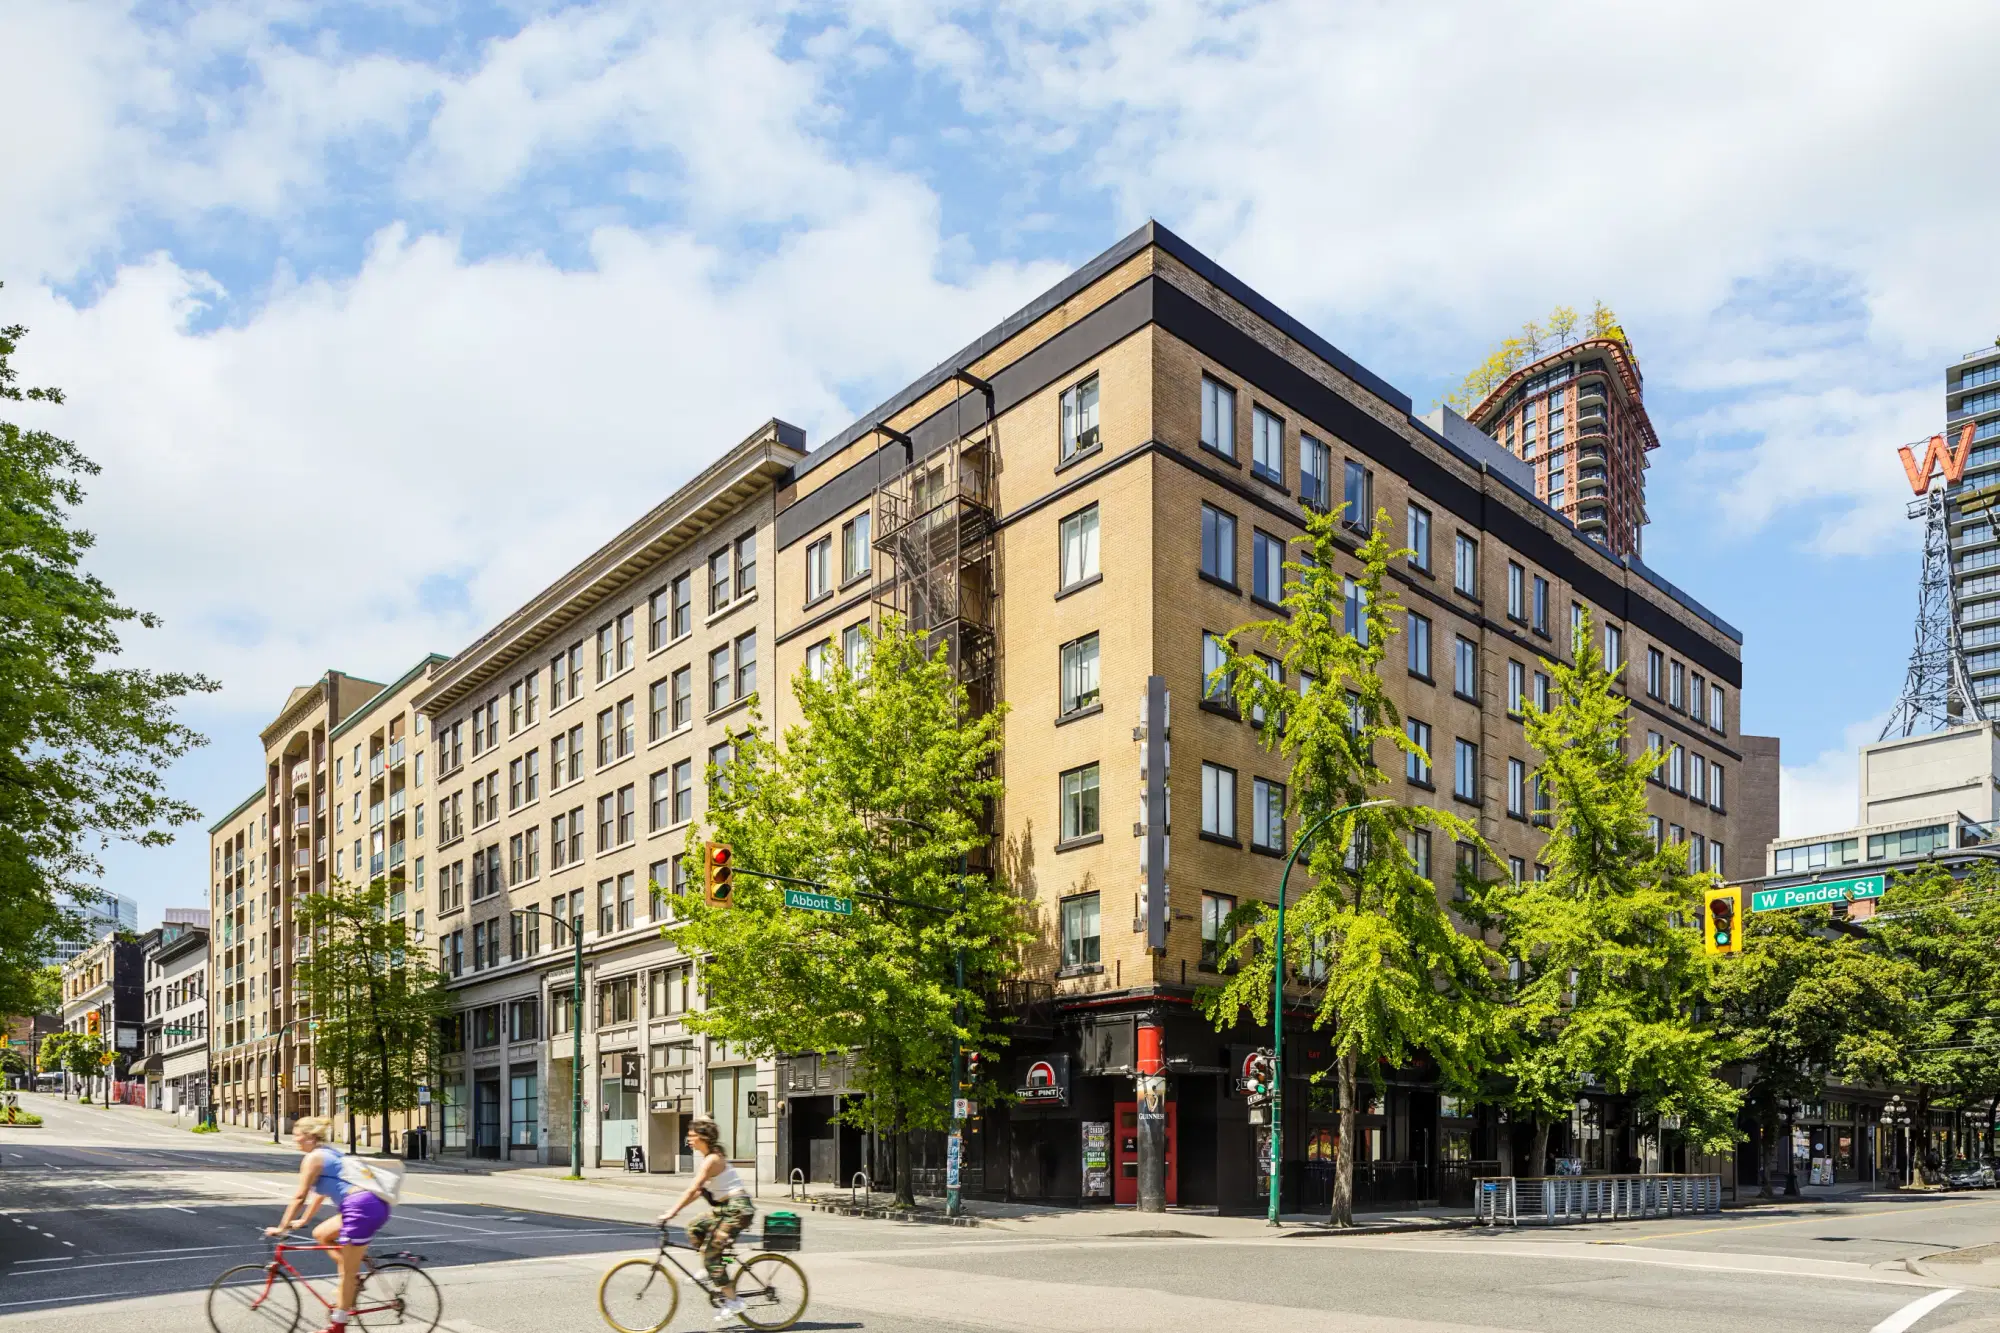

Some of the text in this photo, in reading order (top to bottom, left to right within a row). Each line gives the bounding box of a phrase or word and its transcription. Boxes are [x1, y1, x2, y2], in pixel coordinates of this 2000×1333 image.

[1897, 420, 1977, 496] W
[792, 894, 846, 912] Abbott St
[1761, 881, 1874, 907] W Pender St
[1308, 1051, 1321, 1059] EAT
